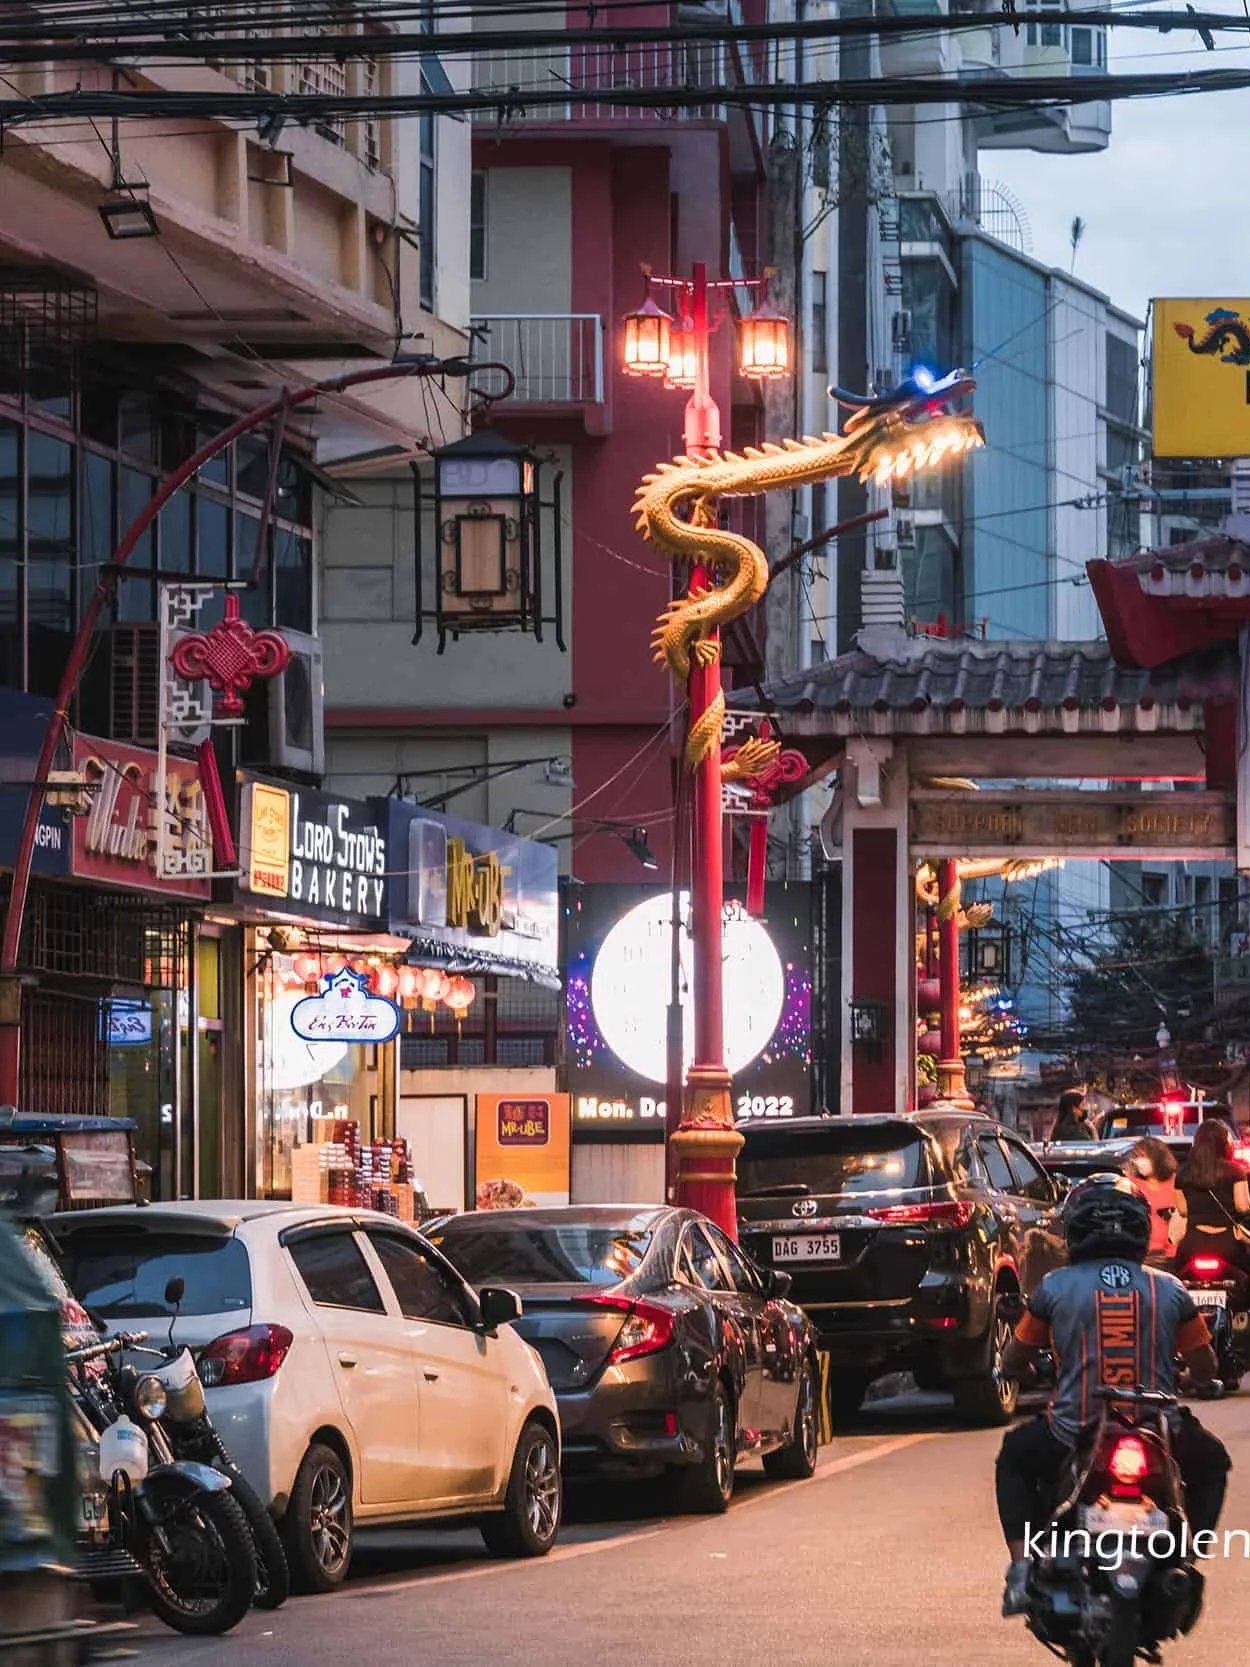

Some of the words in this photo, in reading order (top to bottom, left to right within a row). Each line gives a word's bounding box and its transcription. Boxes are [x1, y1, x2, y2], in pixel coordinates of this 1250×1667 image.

[292, 793, 334, 864] LORD
[292, 859, 384, 918] BAKERY
[578, 1097, 633, 1118] Mon.
[738, 1096, 794, 1118] 2022
[775, 1241, 798, 1257] DAG
[807, 1239, 838, 1255] 3755
[1101, 1264, 1130, 1288] SPX
[1100, 1291, 1135, 1348] MILE
